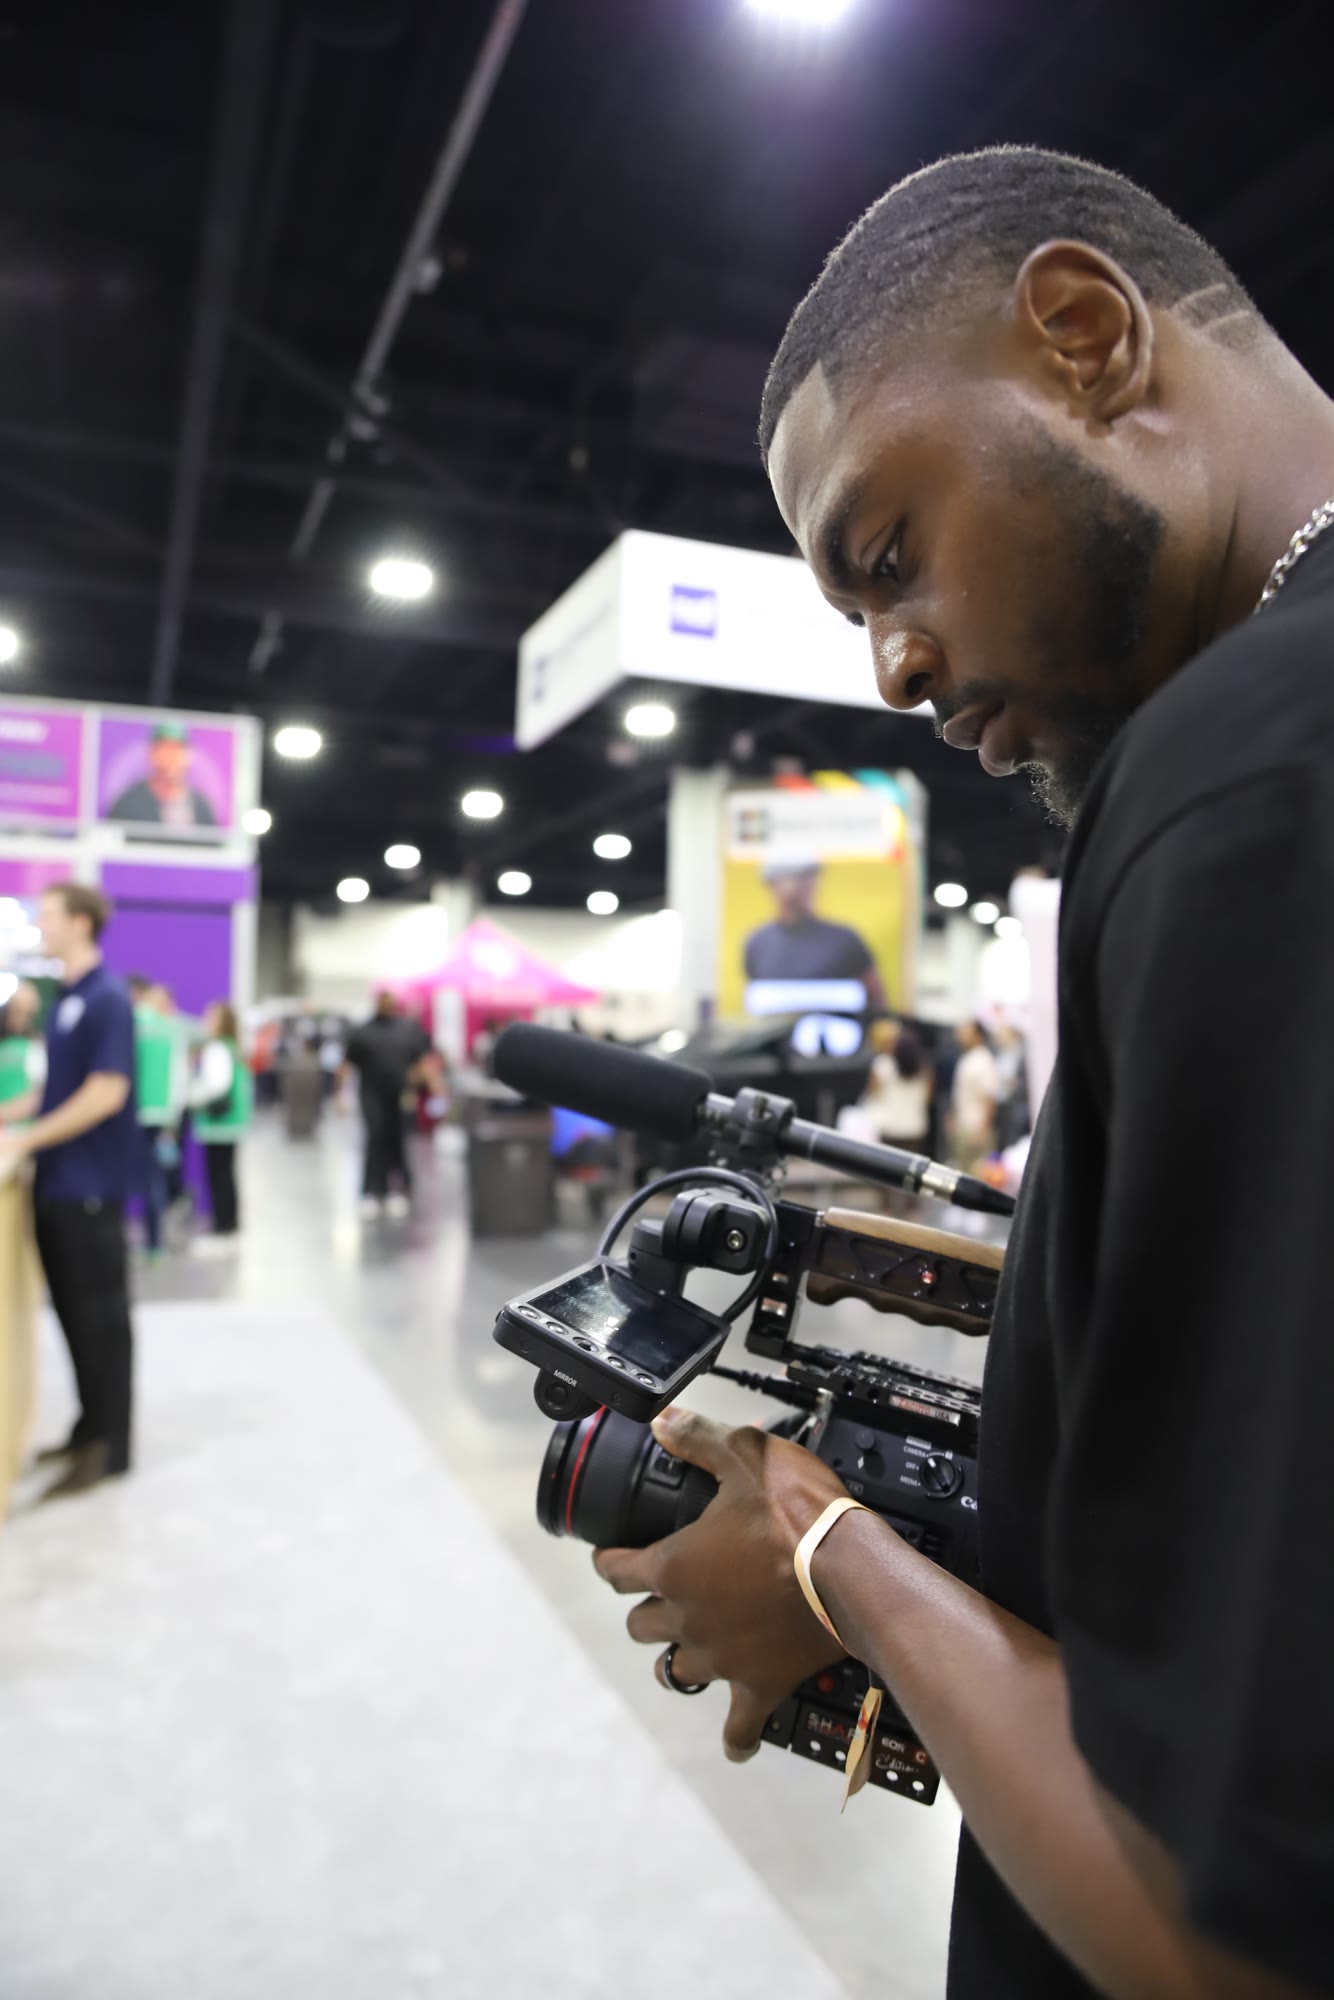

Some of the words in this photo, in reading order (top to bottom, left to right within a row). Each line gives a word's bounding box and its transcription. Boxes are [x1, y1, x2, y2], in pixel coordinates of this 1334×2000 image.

[553, 1369, 578, 1387] MIRROR
[935, 1410, 950, 1421] USA
[903, 1446, 926, 1458] CAMERA
[905, 1462, 916, 1470] OFF
[900, 1475, 918, 1486] MEDIA
[915, 1751, 926, 1764] C
